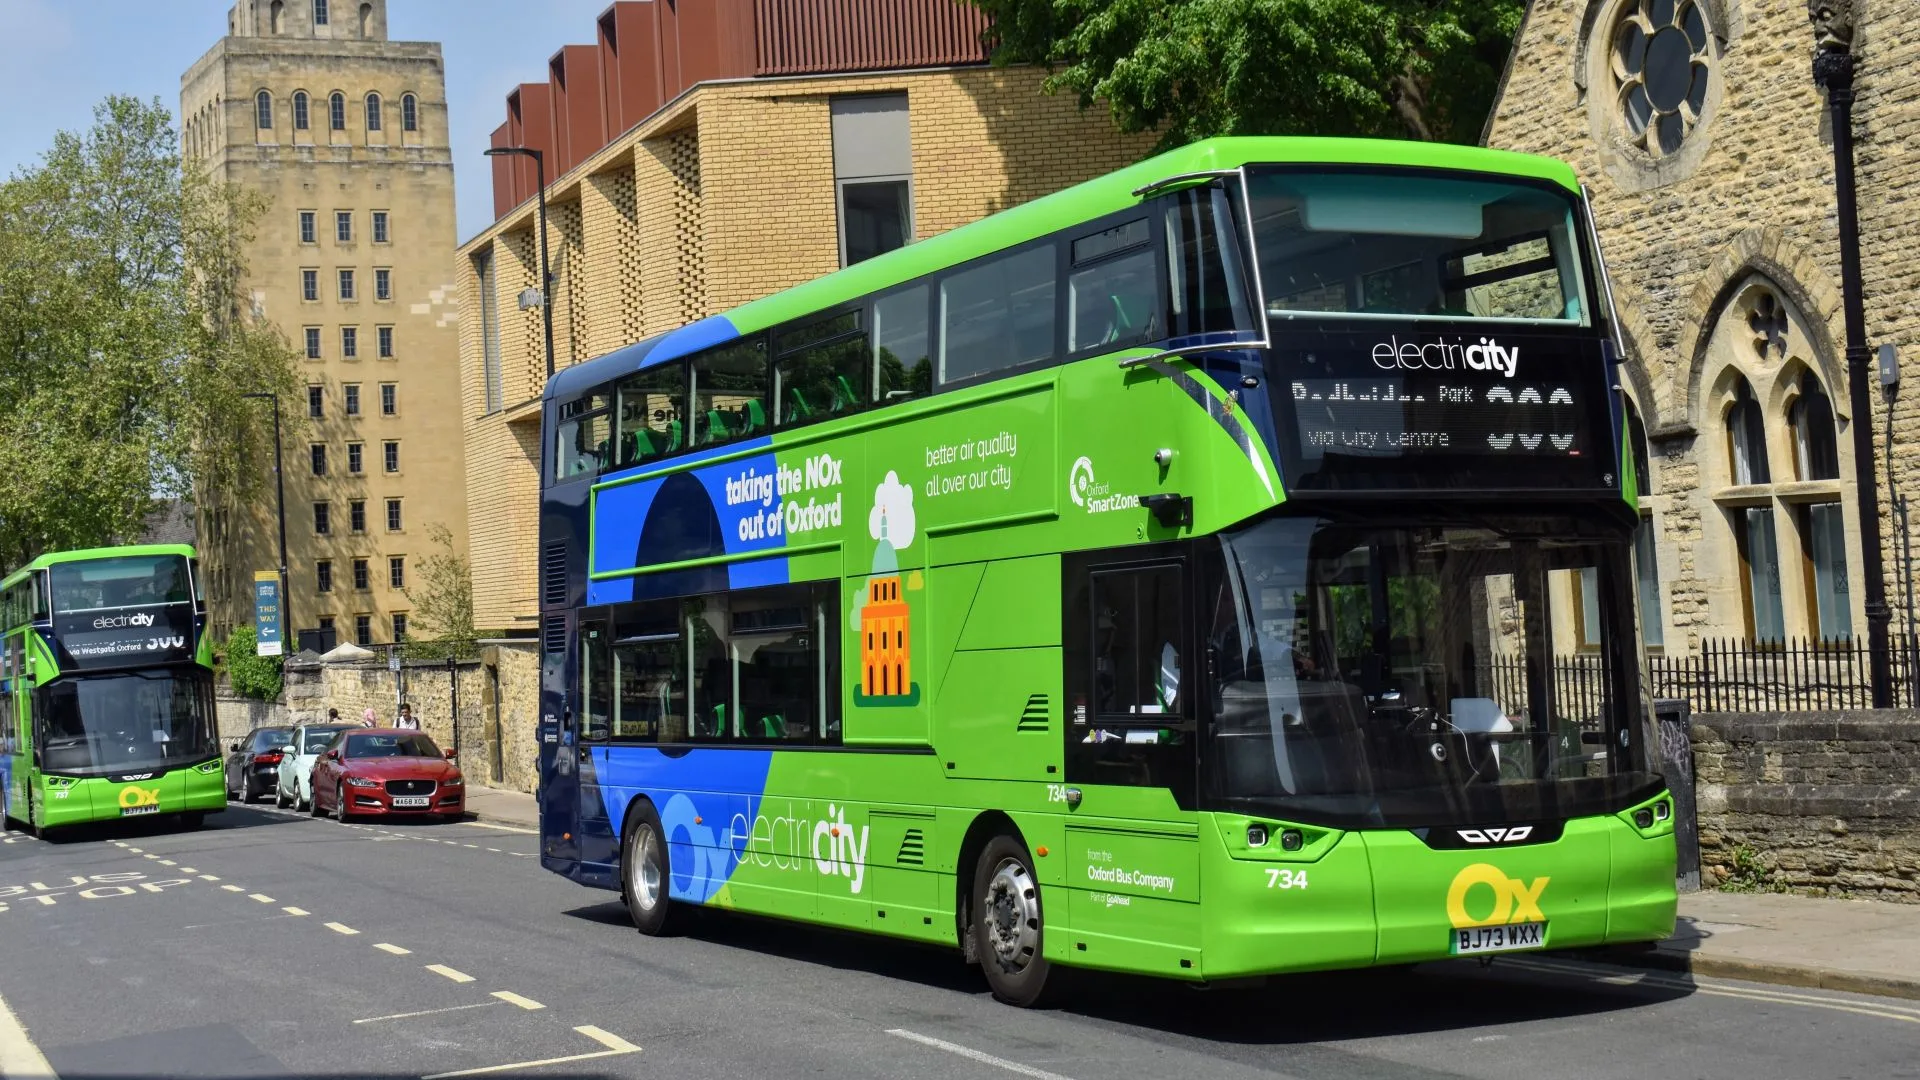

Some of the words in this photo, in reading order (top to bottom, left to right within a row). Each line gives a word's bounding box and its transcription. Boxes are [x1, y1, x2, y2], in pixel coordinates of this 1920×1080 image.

[1372, 334, 1519, 378] electricity
[1439, 385, 1473, 402] Park
[926, 445, 958, 468] better
[960, 438, 975, 461] air
[977, 431, 1017, 462] quality
[726, 467, 773, 507] taking
[776, 462, 802, 496] the
[805, 453, 842, 491] NOx
[926, 474, 940, 497] all
[942, 474, 967, 494] over
[969, 470, 988, 490] our
[990, 463, 1011, 490] city
[1086, 481, 1110, 497] Oxford
[1087, 493, 1140, 514] SmartZone
[738, 509, 765, 542] out
[766, 502, 784, 537] of
[785, 492, 842, 534] Oxford
[93, 612, 155, 629] electricity
[259, 605, 277, 613] THIS
[81, 645, 116, 656] Westgate
[118, 642, 142, 652] Oxford
[119, 785, 161, 808] Ox
[1047, 784, 1067, 803] 734
[730, 796, 869, 894] electricity
[1087, 848, 1101, 860] from
[1102, 849, 1113, 862] the
[1087, 864, 1115, 883] Oxford
[1116, 868, 1132, 884] Bus
[1133, 870, 1174, 893] Company
[1264, 869, 1308, 889] 734
[1446, 863, 1551, 929] Ox
[1460, 928, 1504, 950] BJ73
[1508, 924, 1540, 945] WXX
